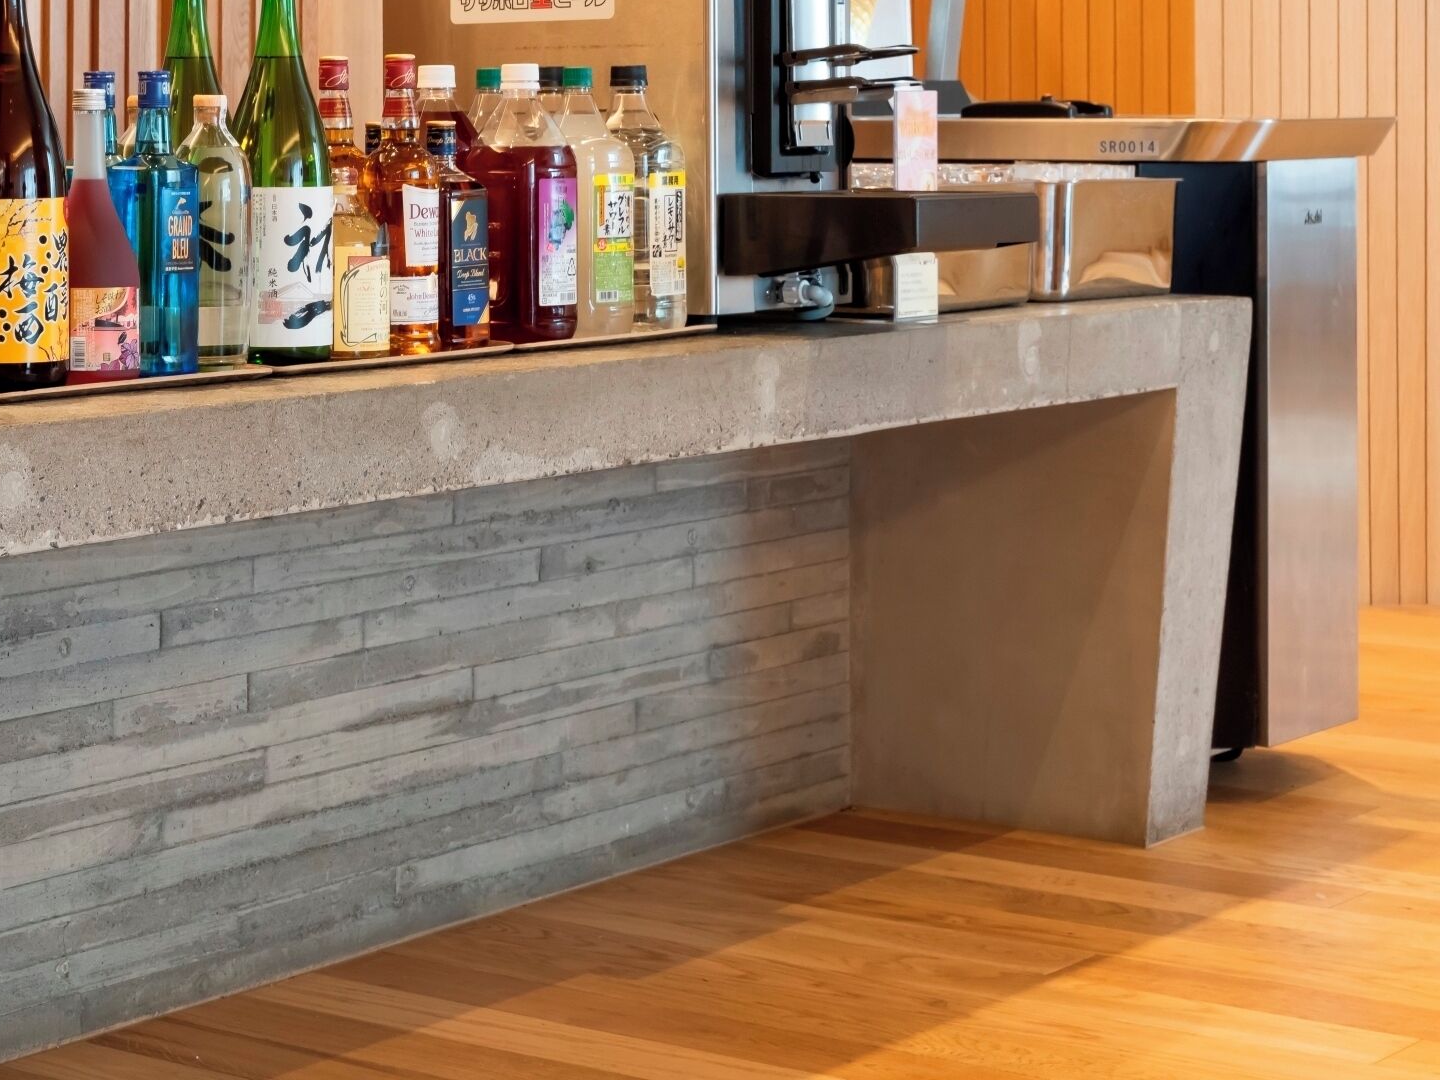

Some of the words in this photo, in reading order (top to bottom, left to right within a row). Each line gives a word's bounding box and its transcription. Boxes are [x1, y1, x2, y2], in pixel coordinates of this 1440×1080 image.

[1099, 140, 1155, 153] SR0014
[168, 215, 193, 237] GRAND
[172, 238, 189, 260] BLEU
[453, 247, 487, 264] BLACK
[267, 267, 278, 299] 純米酒
